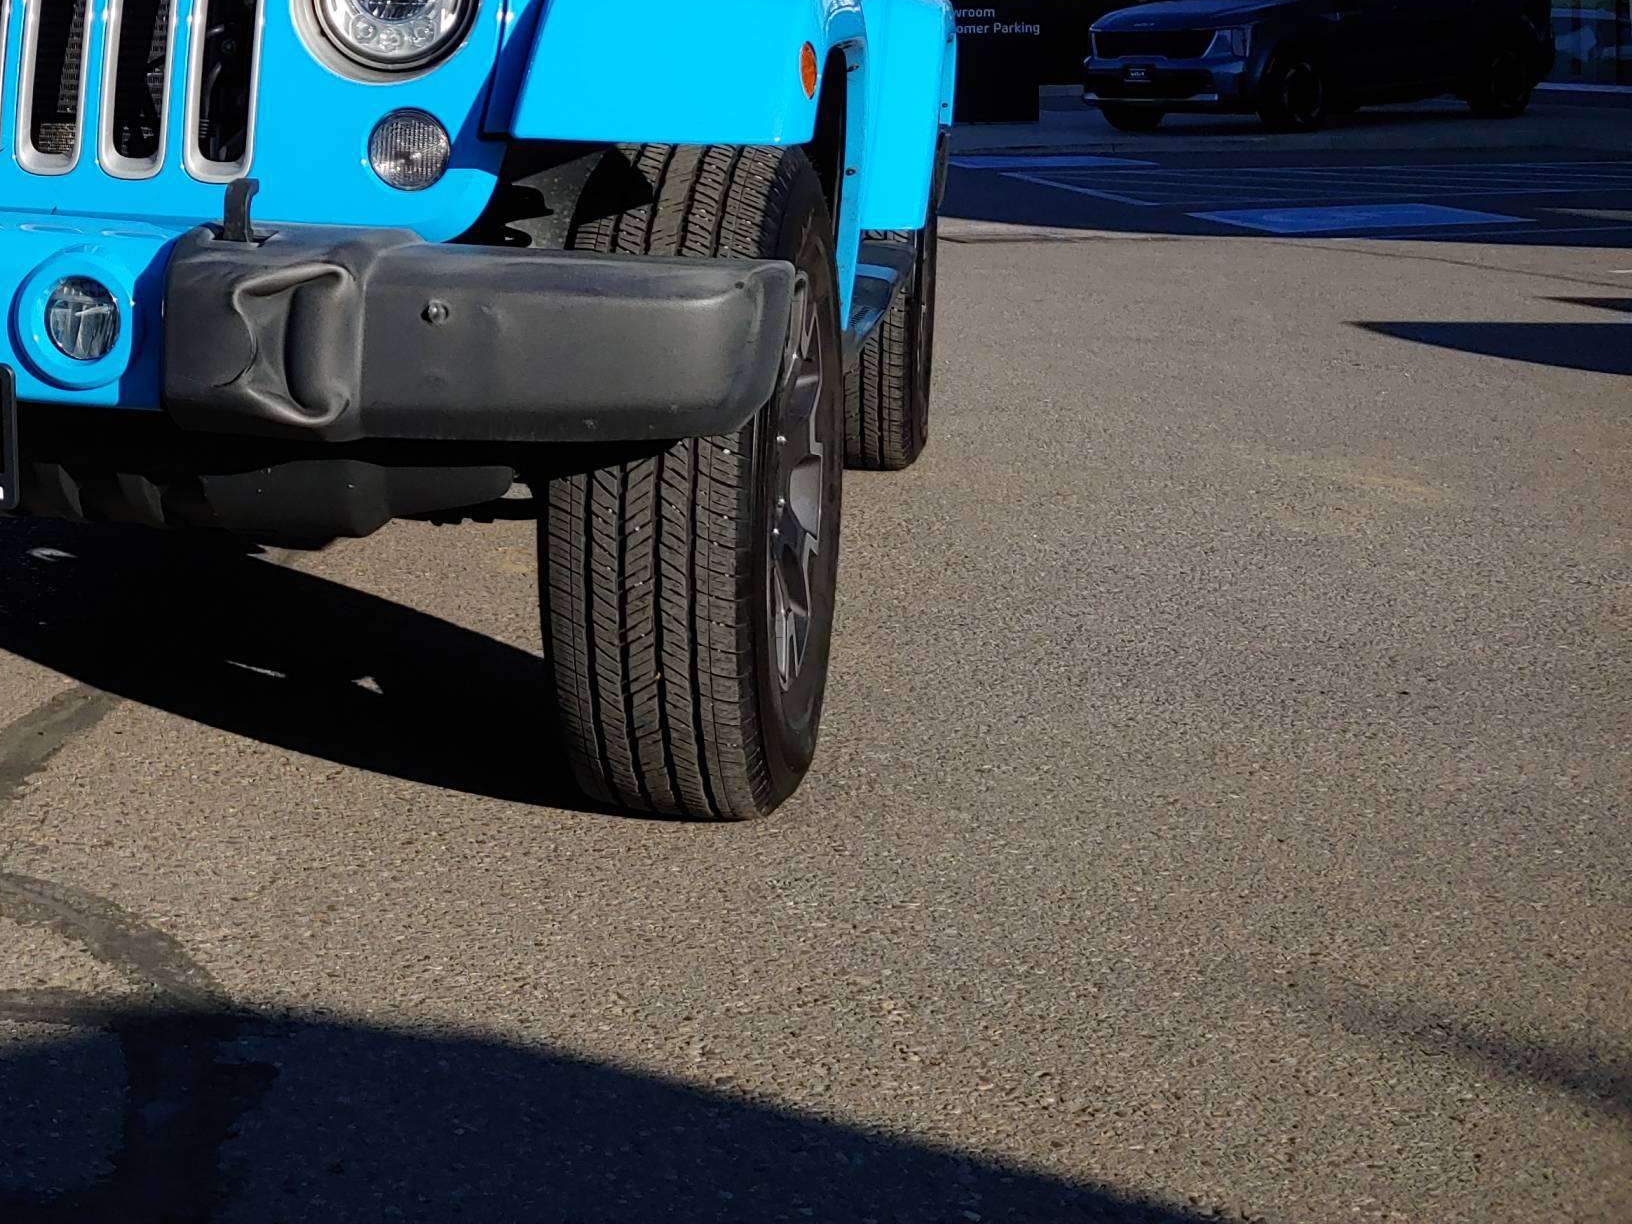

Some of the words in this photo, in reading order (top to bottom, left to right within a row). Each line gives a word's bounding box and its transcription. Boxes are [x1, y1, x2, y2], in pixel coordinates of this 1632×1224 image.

[953, 8, 995, 17] wroom
[956, 24, 990, 34] omer
[993, 22, 1040, 35] Parking
